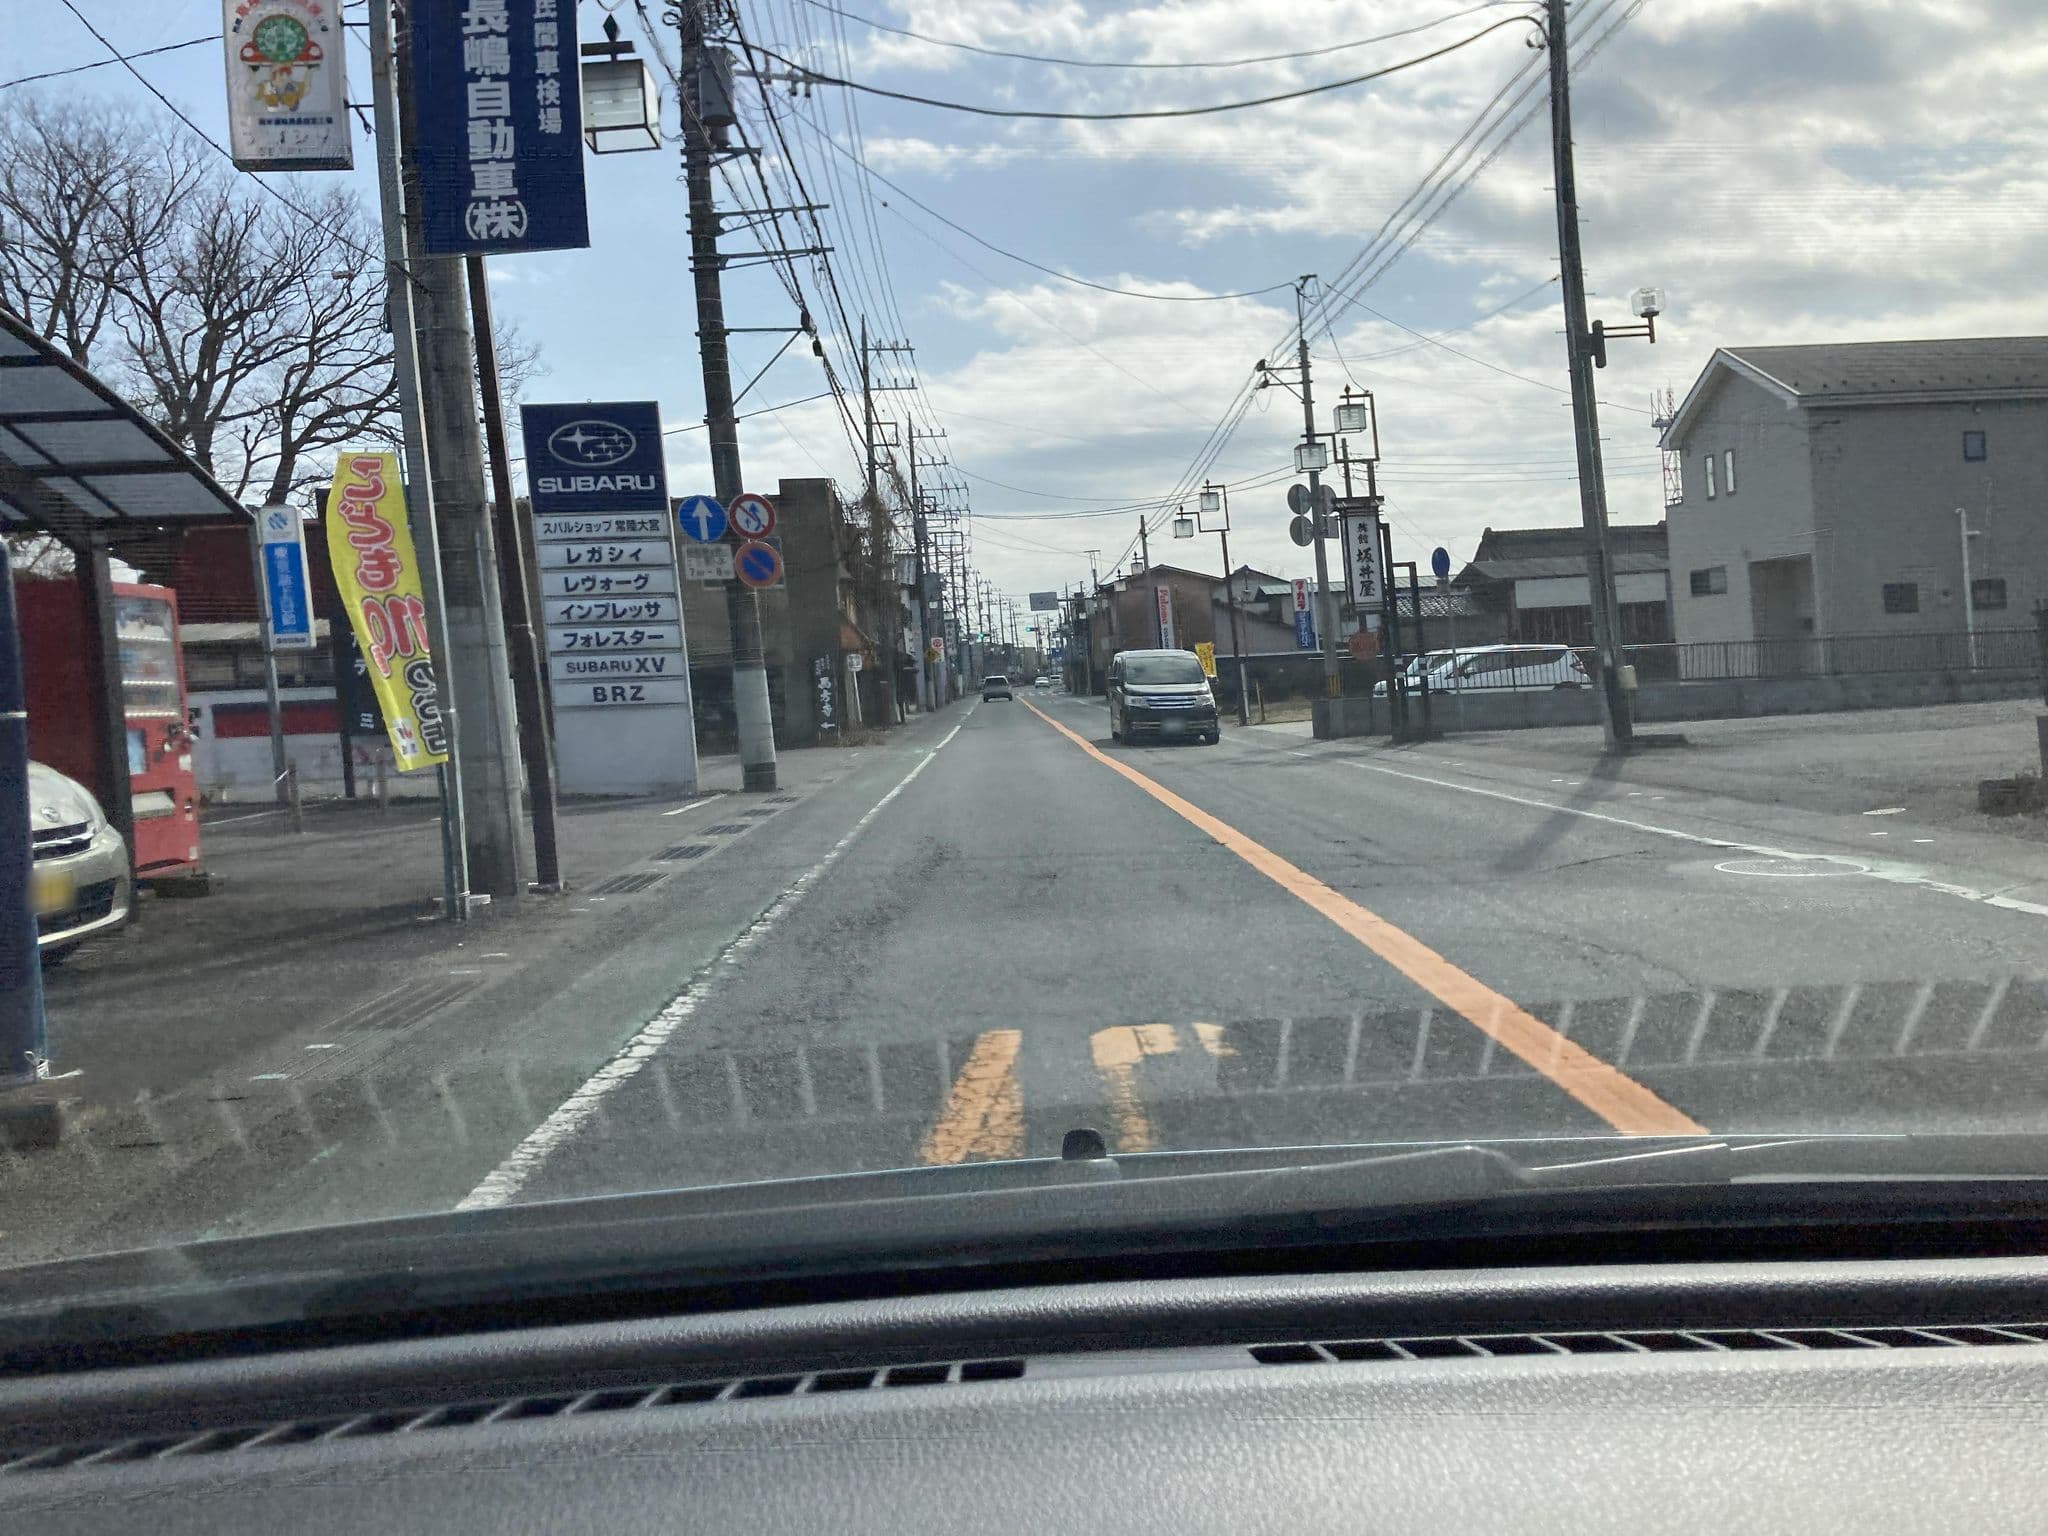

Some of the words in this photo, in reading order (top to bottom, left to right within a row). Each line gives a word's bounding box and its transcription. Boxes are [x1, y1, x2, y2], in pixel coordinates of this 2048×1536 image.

[537, 475, 656, 493] SUBARU
[543, 520, 612, 534] スバルショップ
[615, 518, 661, 532] 常陸大宮
[566, 546, 643, 564] レガシィ
[1356, 547, 1375, 598] 坂井屋
[564, 573, 650, 593] レヴォーグ
[560, 601, 661, 620] インプレッサ
[563, 630, 665, 648] フォレスター
[566, 660, 632, 673] SUBARU
[635, 657, 666, 673] XV
[592, 686, 645, 703] BRZ
